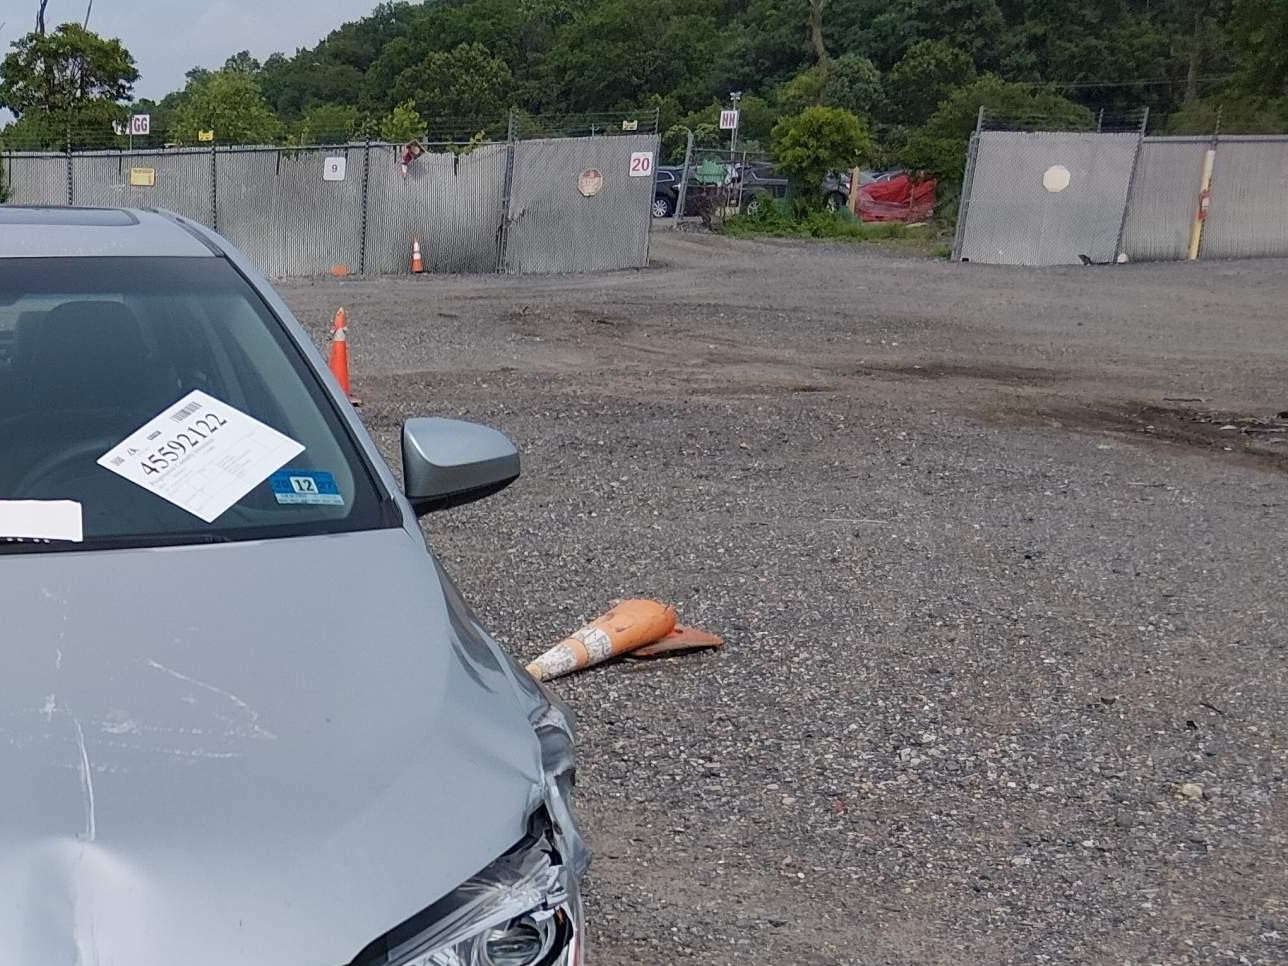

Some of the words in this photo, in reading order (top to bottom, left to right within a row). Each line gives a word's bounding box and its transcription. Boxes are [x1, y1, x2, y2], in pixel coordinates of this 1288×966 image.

[133, 117, 148, 132] GG
[631, 157, 650, 172] 20
[140, 413, 227, 476] 45592122
[294, 479, 314, 491] 12
